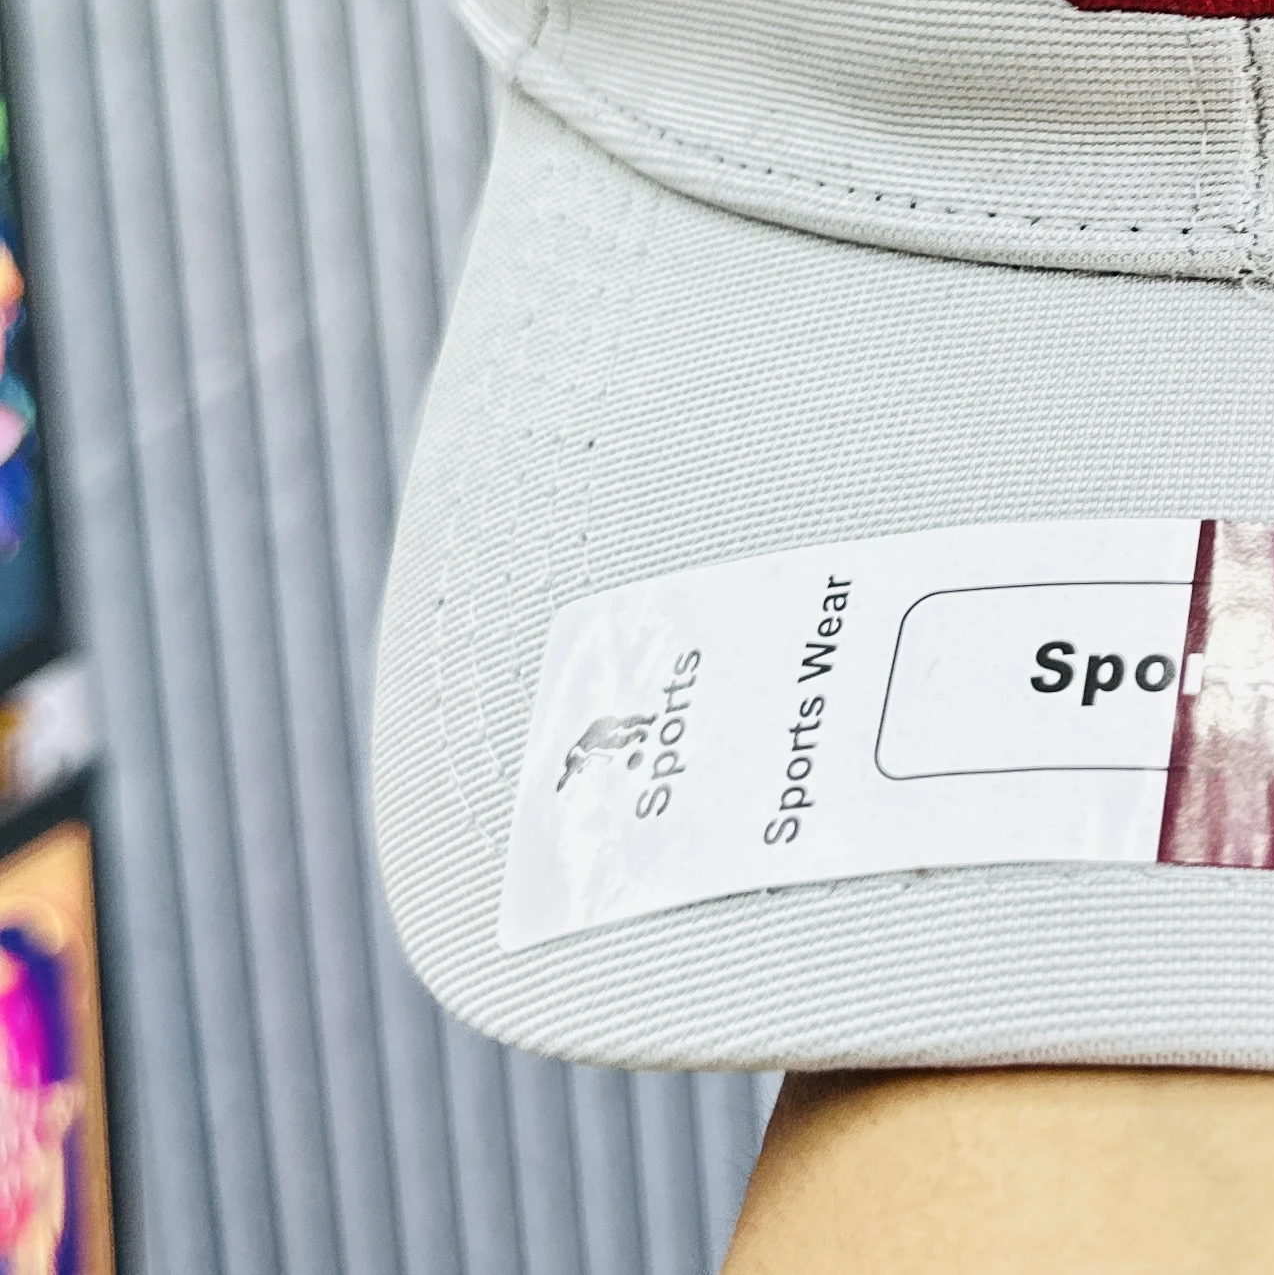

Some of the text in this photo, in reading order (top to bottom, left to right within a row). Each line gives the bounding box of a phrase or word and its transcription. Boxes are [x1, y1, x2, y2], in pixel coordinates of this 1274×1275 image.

[635, 649, 702, 819] Sports
[764, 575, 852, 845] Sports Wear
